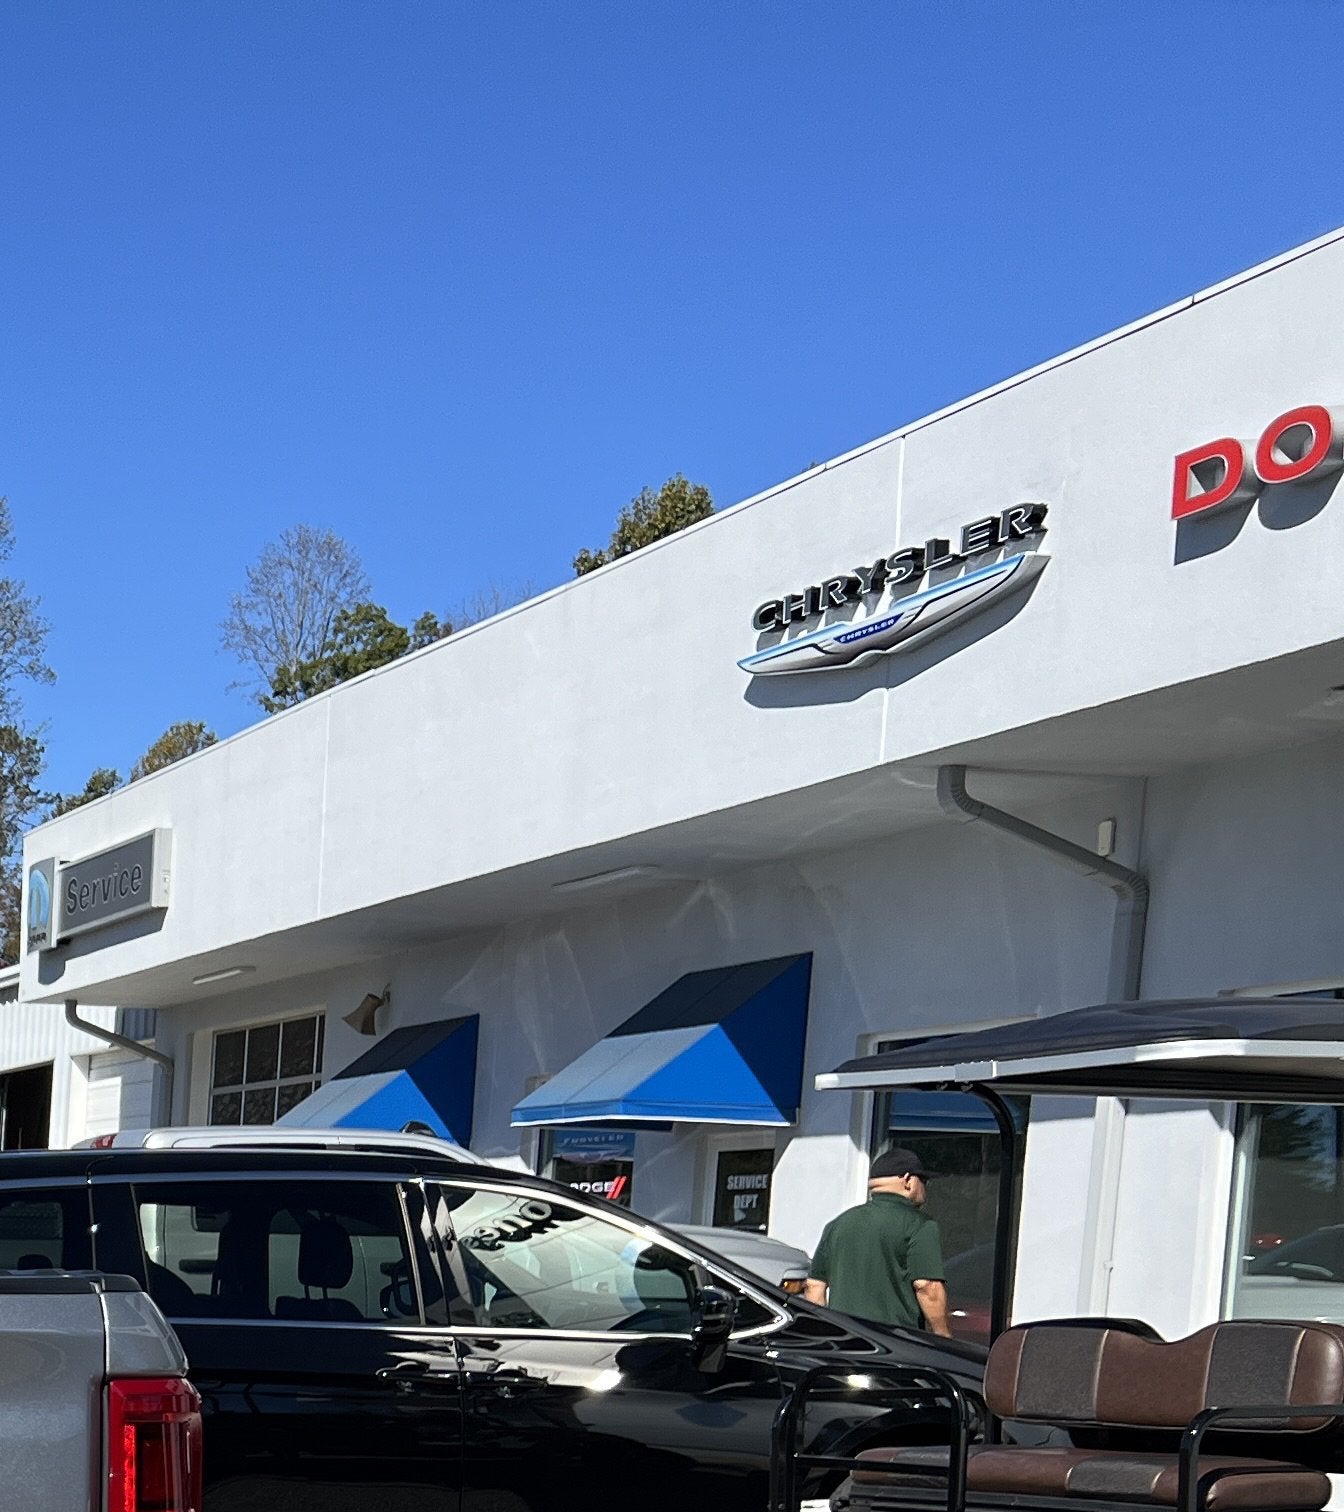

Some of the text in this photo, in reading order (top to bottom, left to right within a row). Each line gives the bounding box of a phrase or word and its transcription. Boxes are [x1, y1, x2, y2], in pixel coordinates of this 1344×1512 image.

[1171, 404, 1334, 520] DO
[752, 503, 1045, 632] CHRYSLER
[839, 618, 895, 642] CHRYSLER
[66, 863, 143, 915] Service
[570, 1181, 614, 1193] DGE
[727, 1174, 768, 1190] SERVICE
[734, 1194, 758, 1209] DEPT
